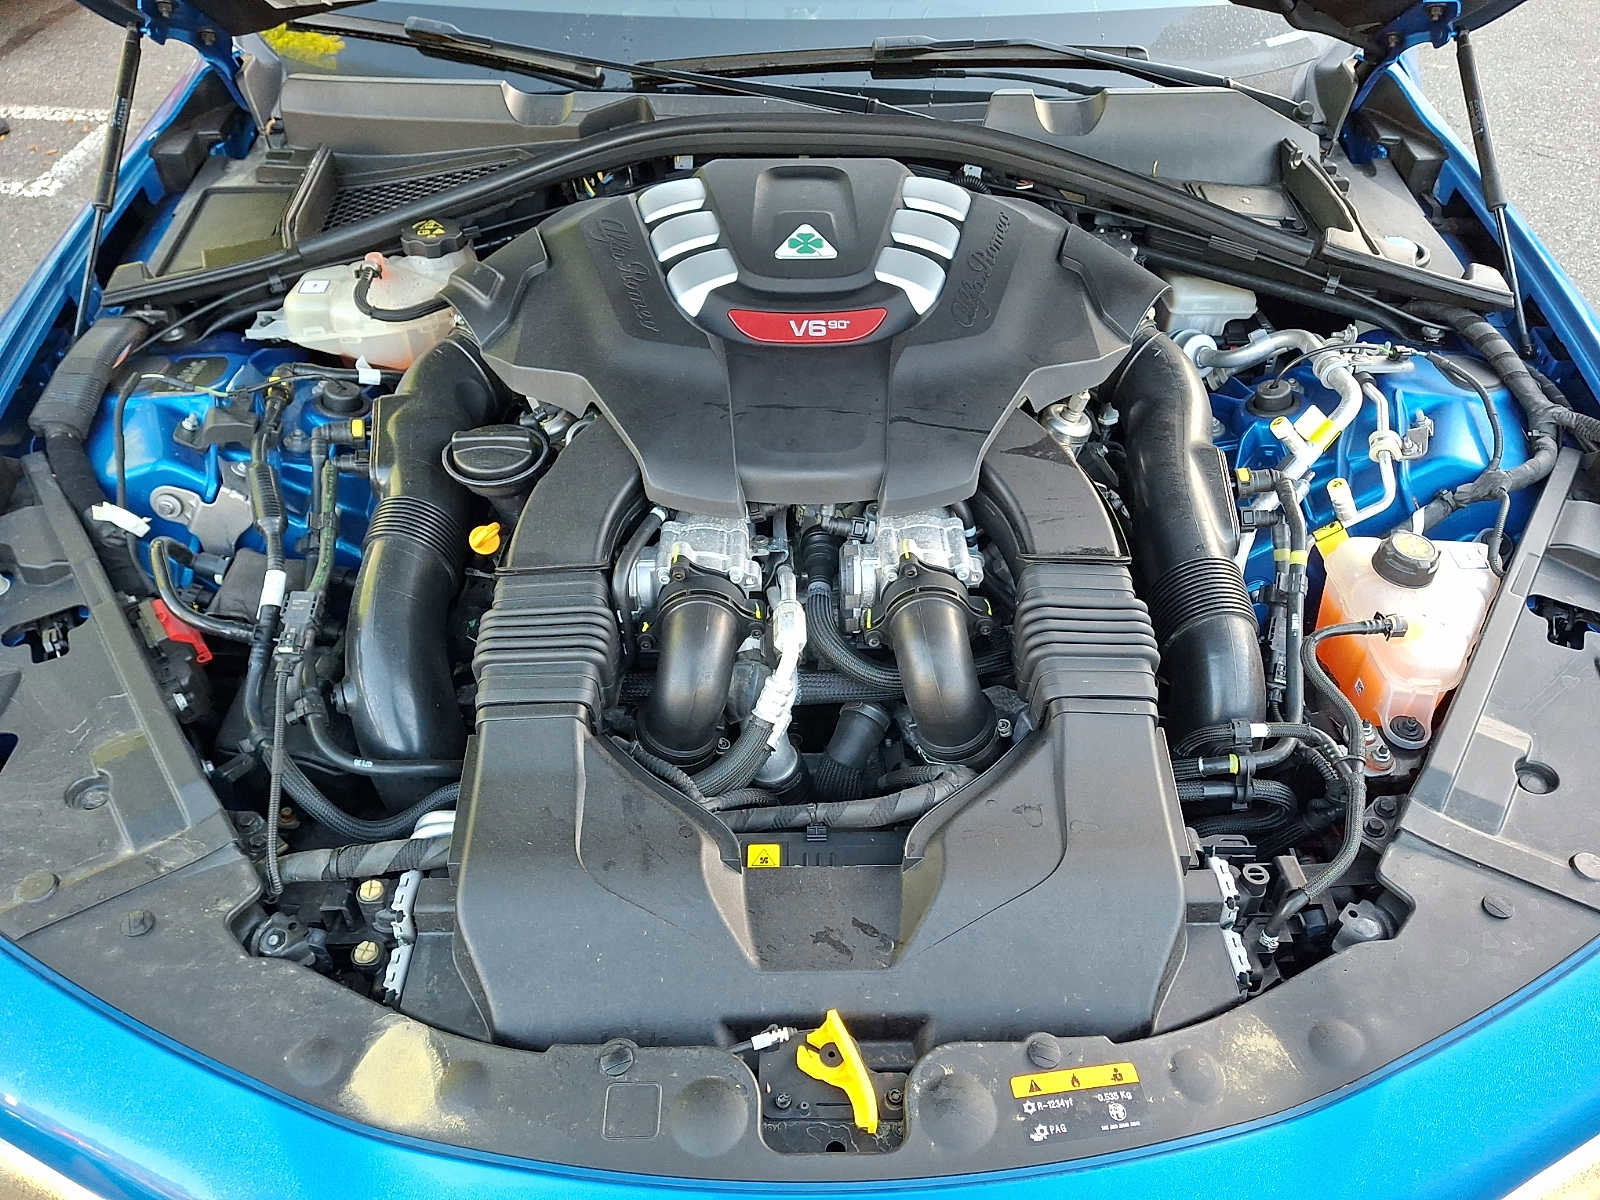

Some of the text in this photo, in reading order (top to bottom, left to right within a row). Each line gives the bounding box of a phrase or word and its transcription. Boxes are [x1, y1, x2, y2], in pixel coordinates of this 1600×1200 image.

[589, 217, 661, 333] Alfa Romeo
[951, 211, 1010, 328] Alfa Romeo
[1036, 1097, 1074, 1111] R-1234yf
[1049, 1123, 1068, 1134] PAG
